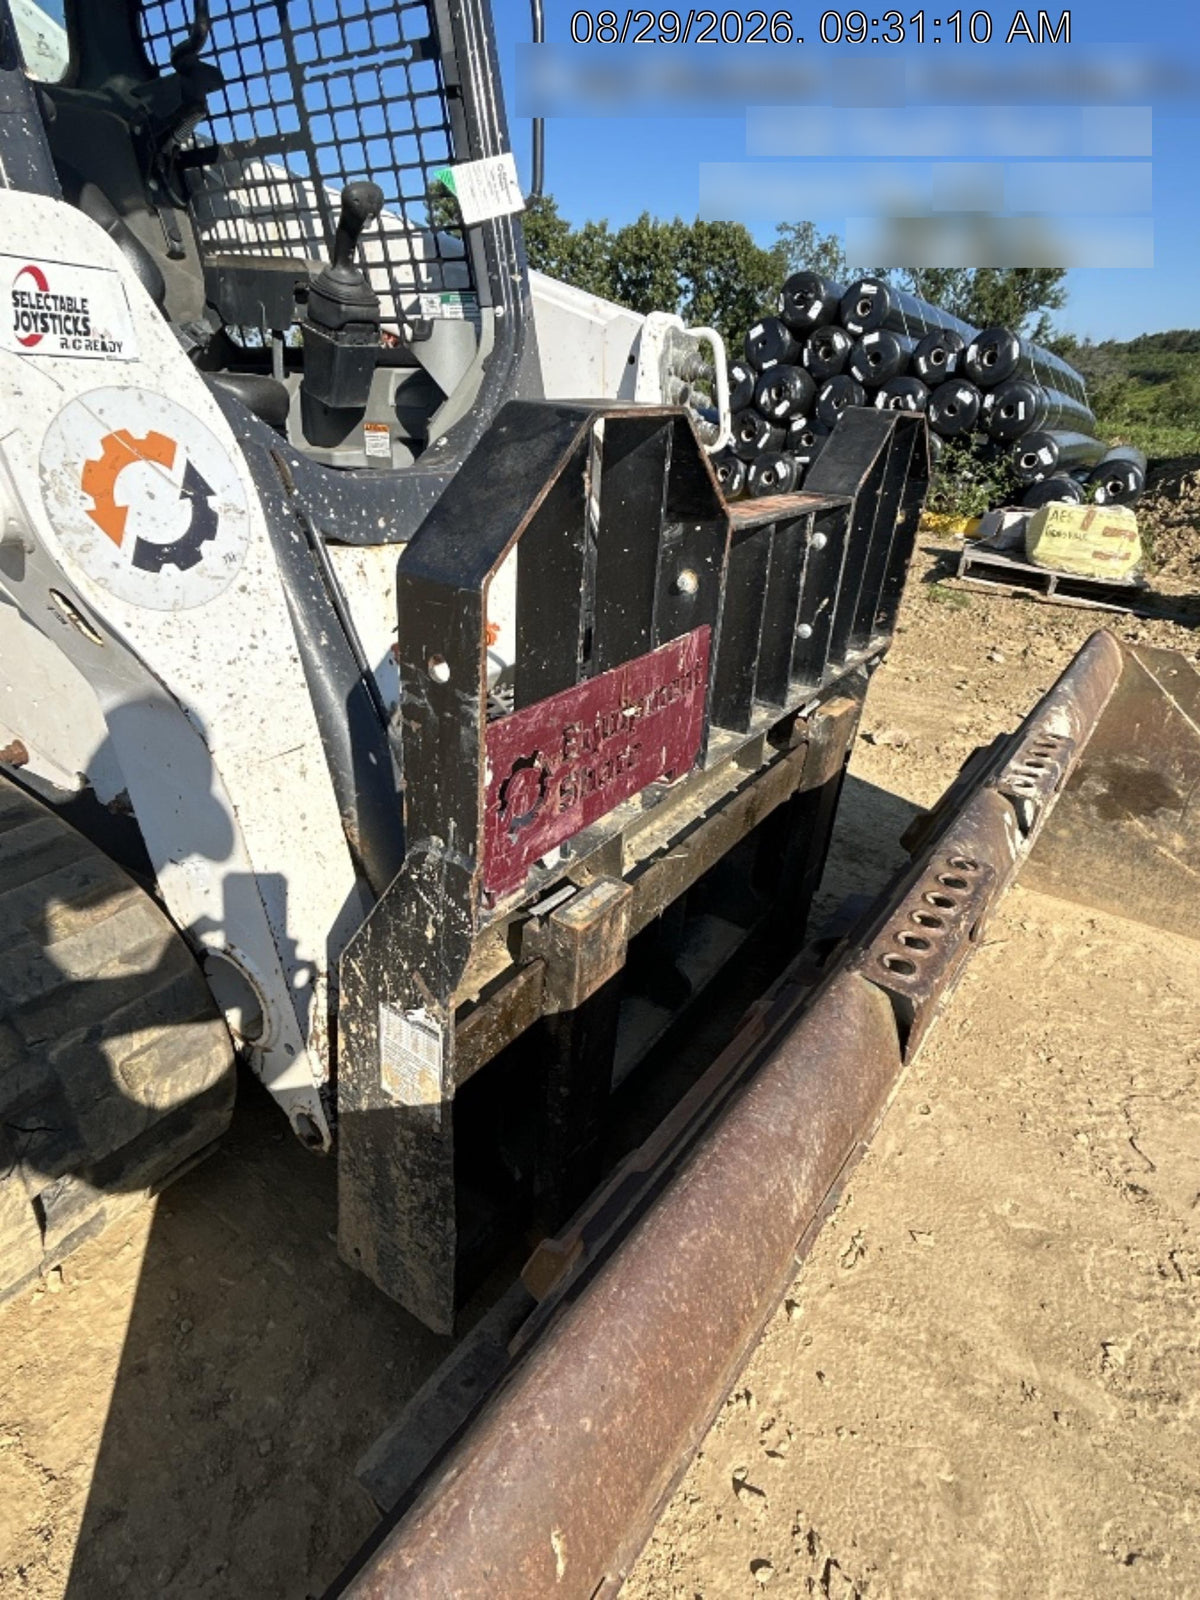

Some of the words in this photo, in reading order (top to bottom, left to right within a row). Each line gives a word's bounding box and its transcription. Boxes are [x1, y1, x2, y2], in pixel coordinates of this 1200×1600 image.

[12, 290, 89, 314] SELECTABLE
[13, 310, 91, 336] JOYSTICKS
[84, 339, 123, 353] READY
